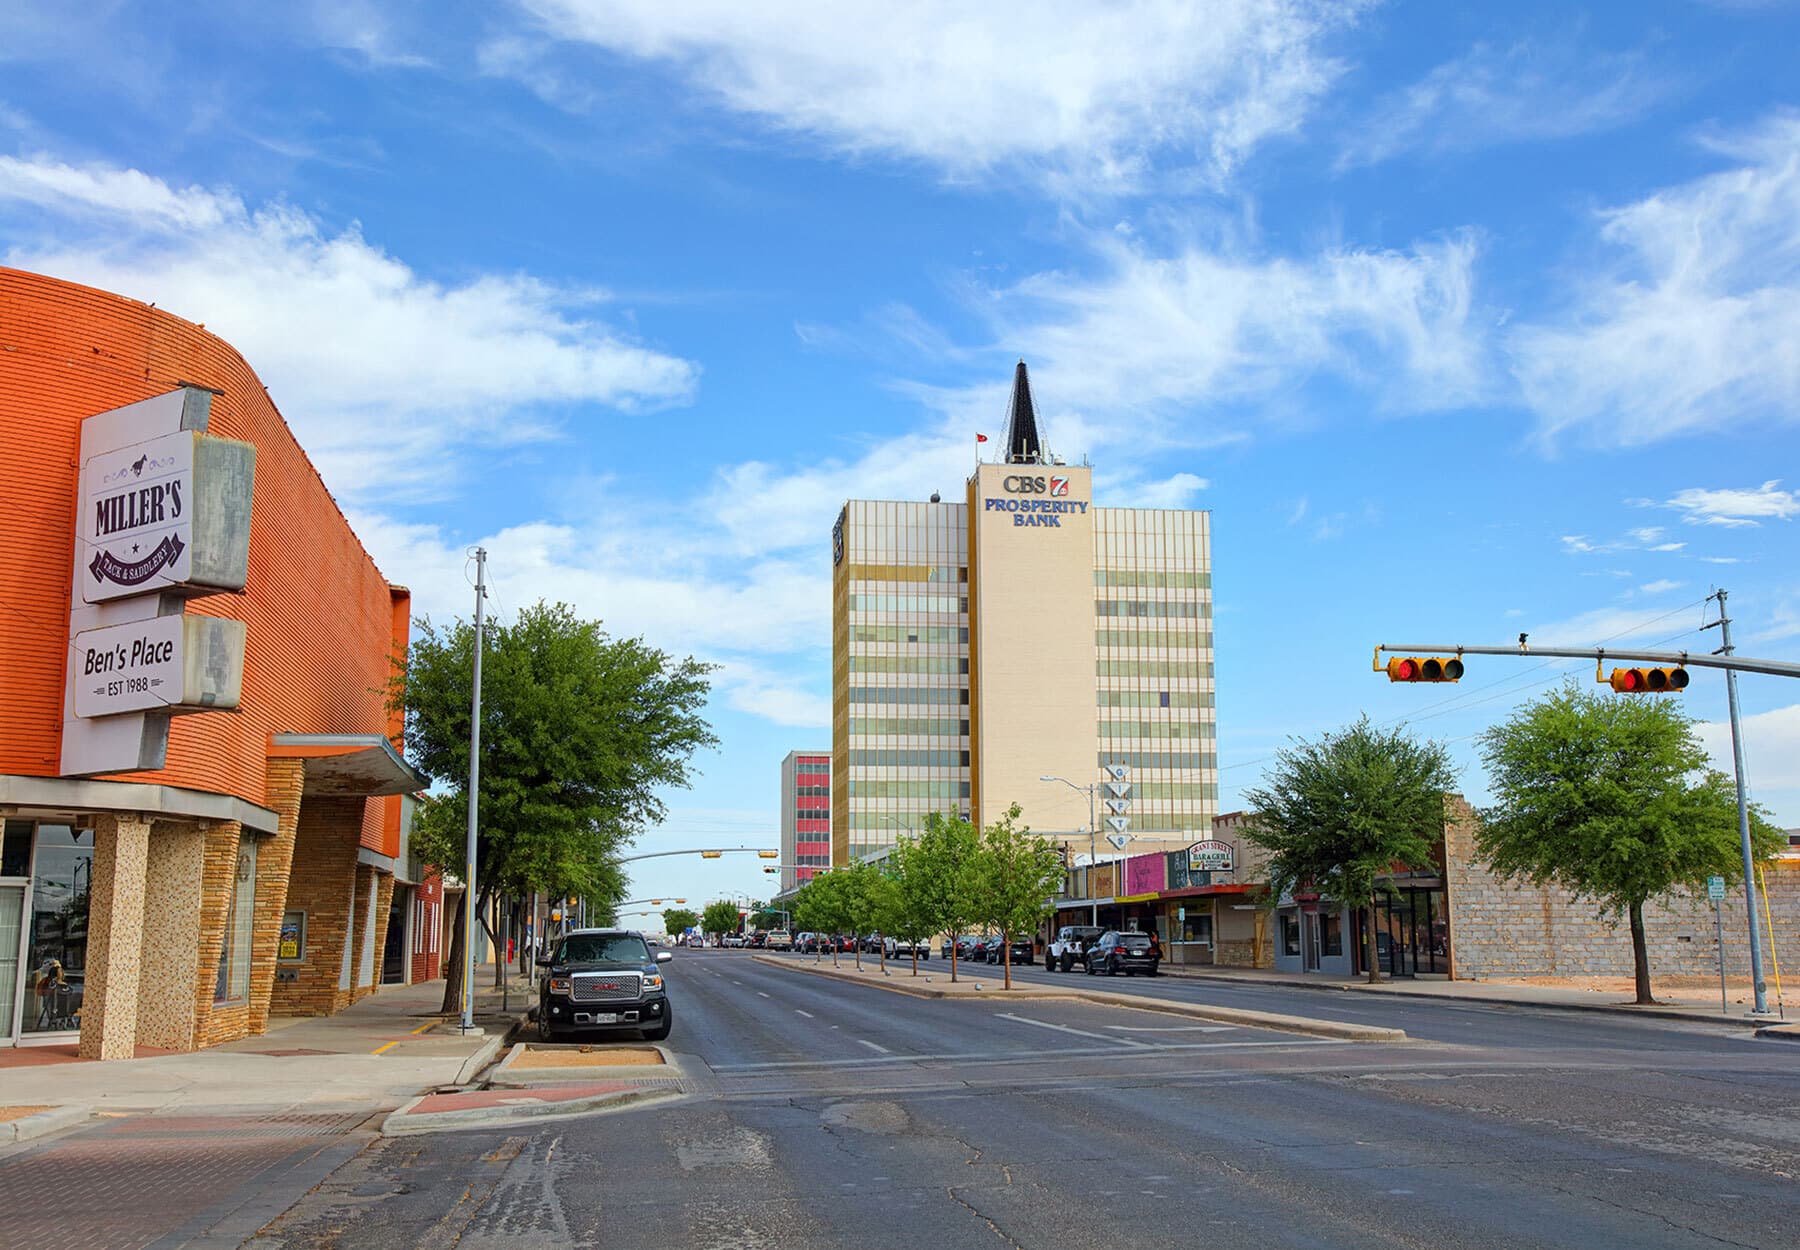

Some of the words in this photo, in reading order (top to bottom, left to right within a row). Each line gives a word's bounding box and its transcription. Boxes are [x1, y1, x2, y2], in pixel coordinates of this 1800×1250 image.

[1003, 475, 1046, 493] CBS
[1051, 476, 1069, 497] 7
[95, 479, 181, 537] MILLER'S
[985, 498, 1088, 513] PROSPERITY
[1013, 514, 1061, 527] BANK
[103, 558, 121, 578] TACK
[122, 569, 128, 580] &
[128, 544, 168, 580] SADDLERY
[84, 643, 127, 675] Ben's
[130, 636, 173, 667] Place
[108, 681, 124, 696] EST
[126, 677, 148, 693] 1988
